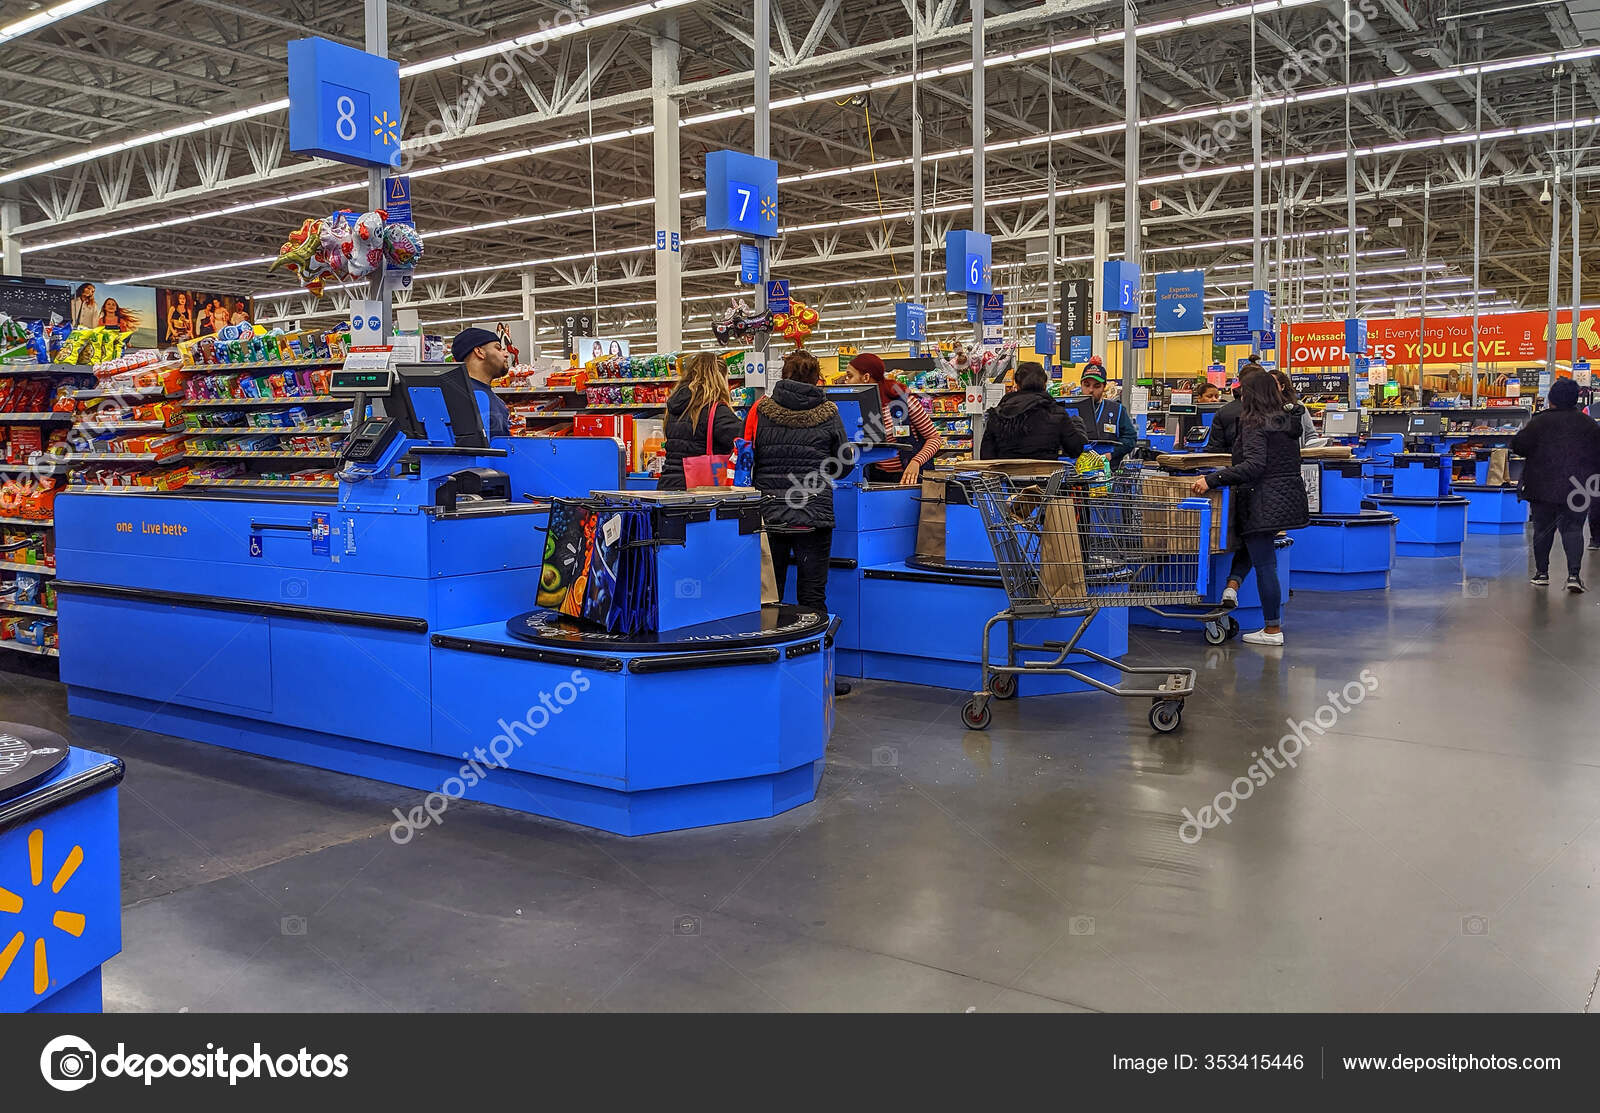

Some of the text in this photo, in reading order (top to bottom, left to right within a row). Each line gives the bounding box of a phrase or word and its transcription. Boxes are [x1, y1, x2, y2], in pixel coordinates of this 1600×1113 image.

[336, 95, 357, 141] 8
[737, 188, 751, 222] 7
[970, 259, 979, 285] 6
[1122, 284, 1130, 306] 5
[1067, 301, 1077, 331] Ladies
[910, 320, 917, 336] 3
[1446, 326, 1468, 336] You
[1329, 344, 1396, 360] PRCES
[1404, 342, 1447, 359] YOU
[1452, 340, 1511, 357] LOVE.
[116, 522, 132, 533] one
